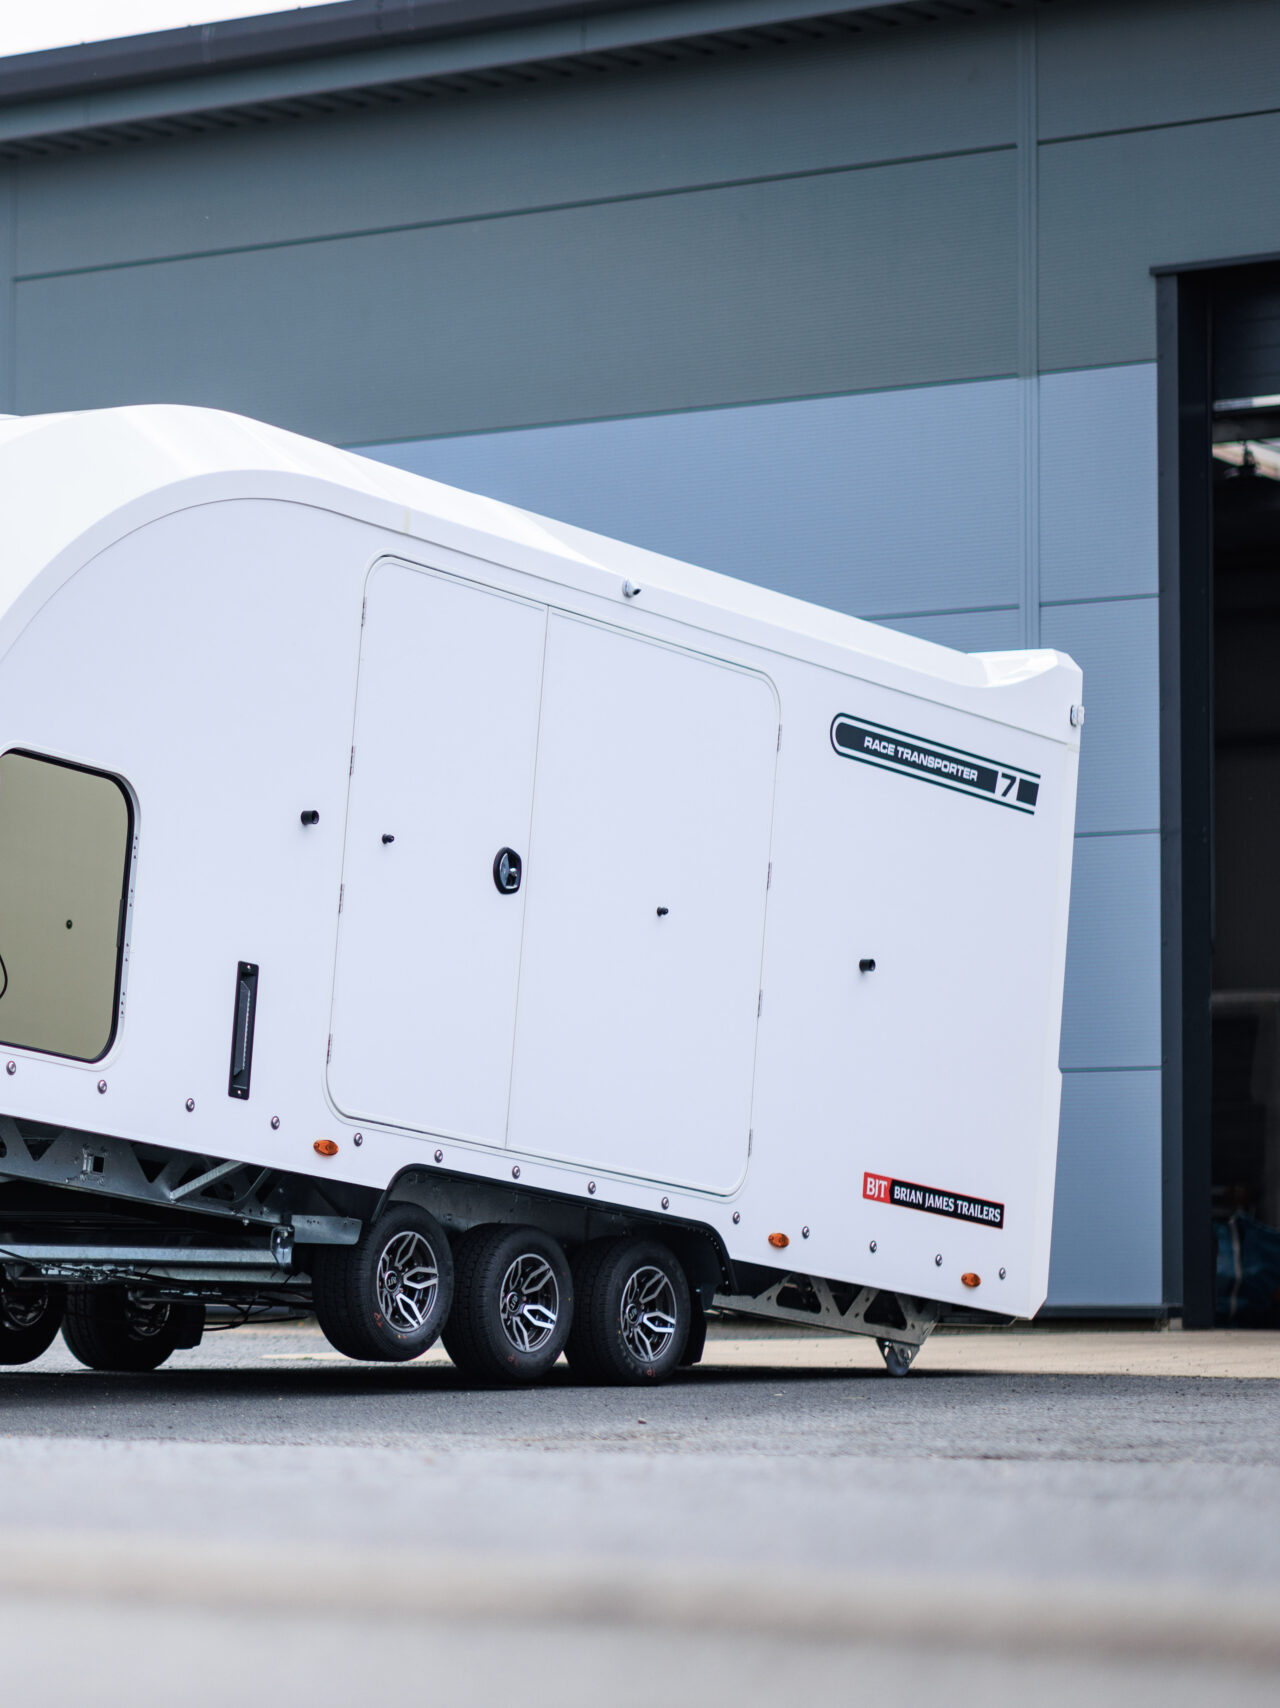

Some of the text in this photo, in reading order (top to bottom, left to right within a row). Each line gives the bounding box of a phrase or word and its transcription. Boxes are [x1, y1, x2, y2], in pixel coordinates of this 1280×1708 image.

[863, 736, 1017, 797] RACE TRANSPORTER 7
[866, 1177, 887, 1198] BJT
[893, 1185, 1001, 1222] BRIAN JAMES TRAILERS
